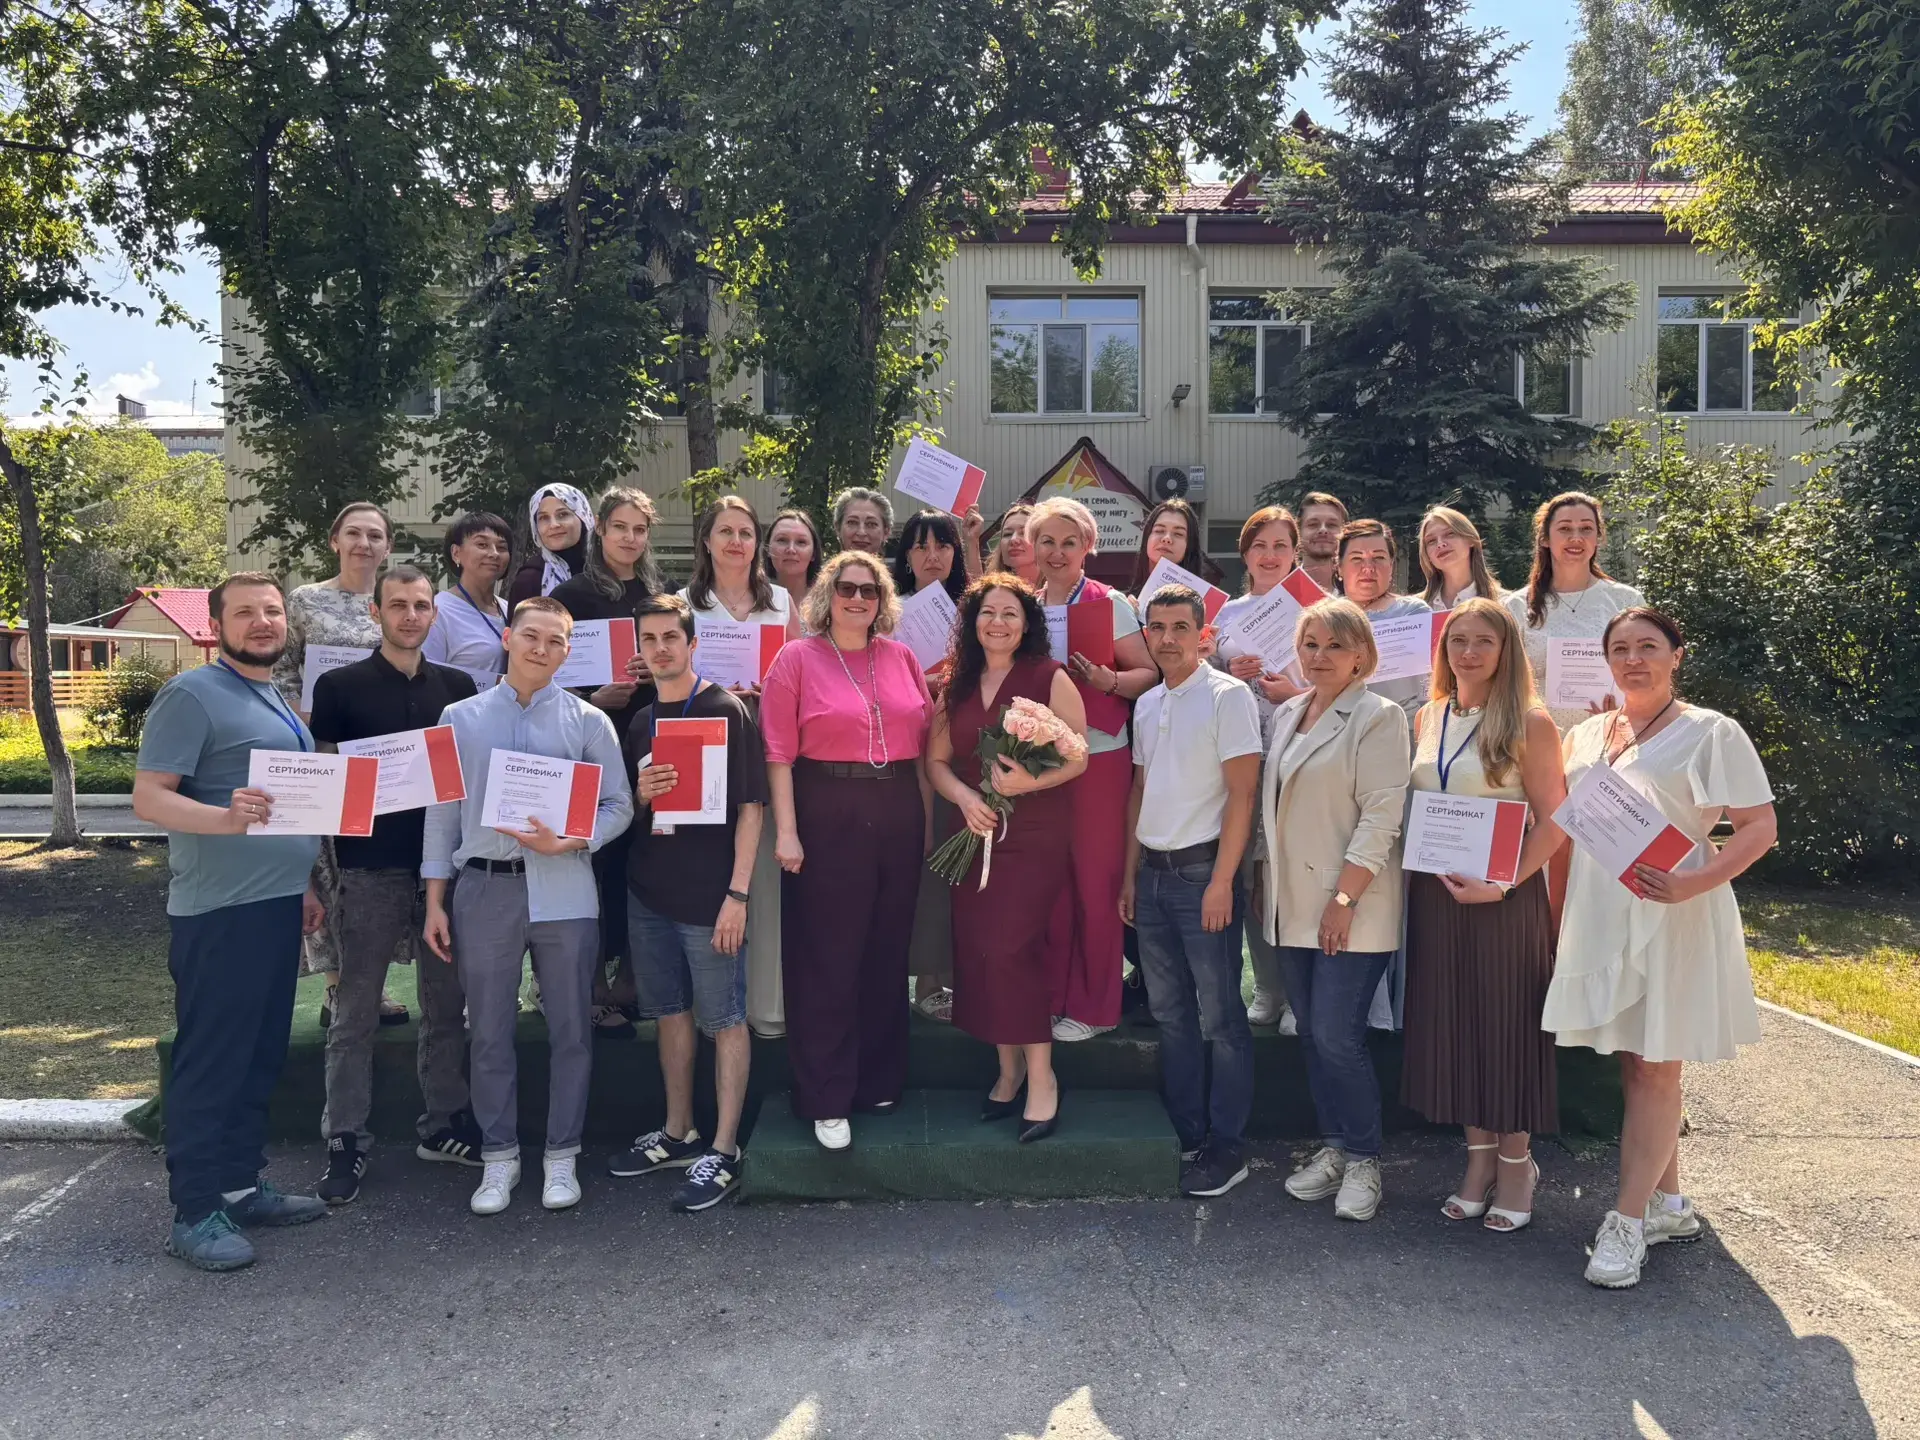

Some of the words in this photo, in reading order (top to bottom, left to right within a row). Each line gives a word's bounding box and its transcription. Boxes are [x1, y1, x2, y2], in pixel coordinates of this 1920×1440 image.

[920, 450, 959, 472] СЕРТИФИКАТ
[1091, 497, 1119, 505] семью,
[1096, 535, 1139, 548] ущее!
[1242, 598, 1284, 633] СЕРТИФИКАТ
[700, 631, 752, 640] СЕРТИФИКАТ
[1373, 624, 1424, 637] СЕРТИФИКАТ
[357, 744, 416, 757] ЕРТИФИКАТ
[268, 765, 336, 776] СЕРТИФИКАТ
[505, 764, 564, 779] СЕРТИФИКАТ
[1599, 781, 1651, 828] СЕРТИФИКАТ
[1426, 806, 1485, 820] СЕРТИФИКАТ
[644, 1144, 670, 1163] N
[713, 1169, 733, 1188] N
